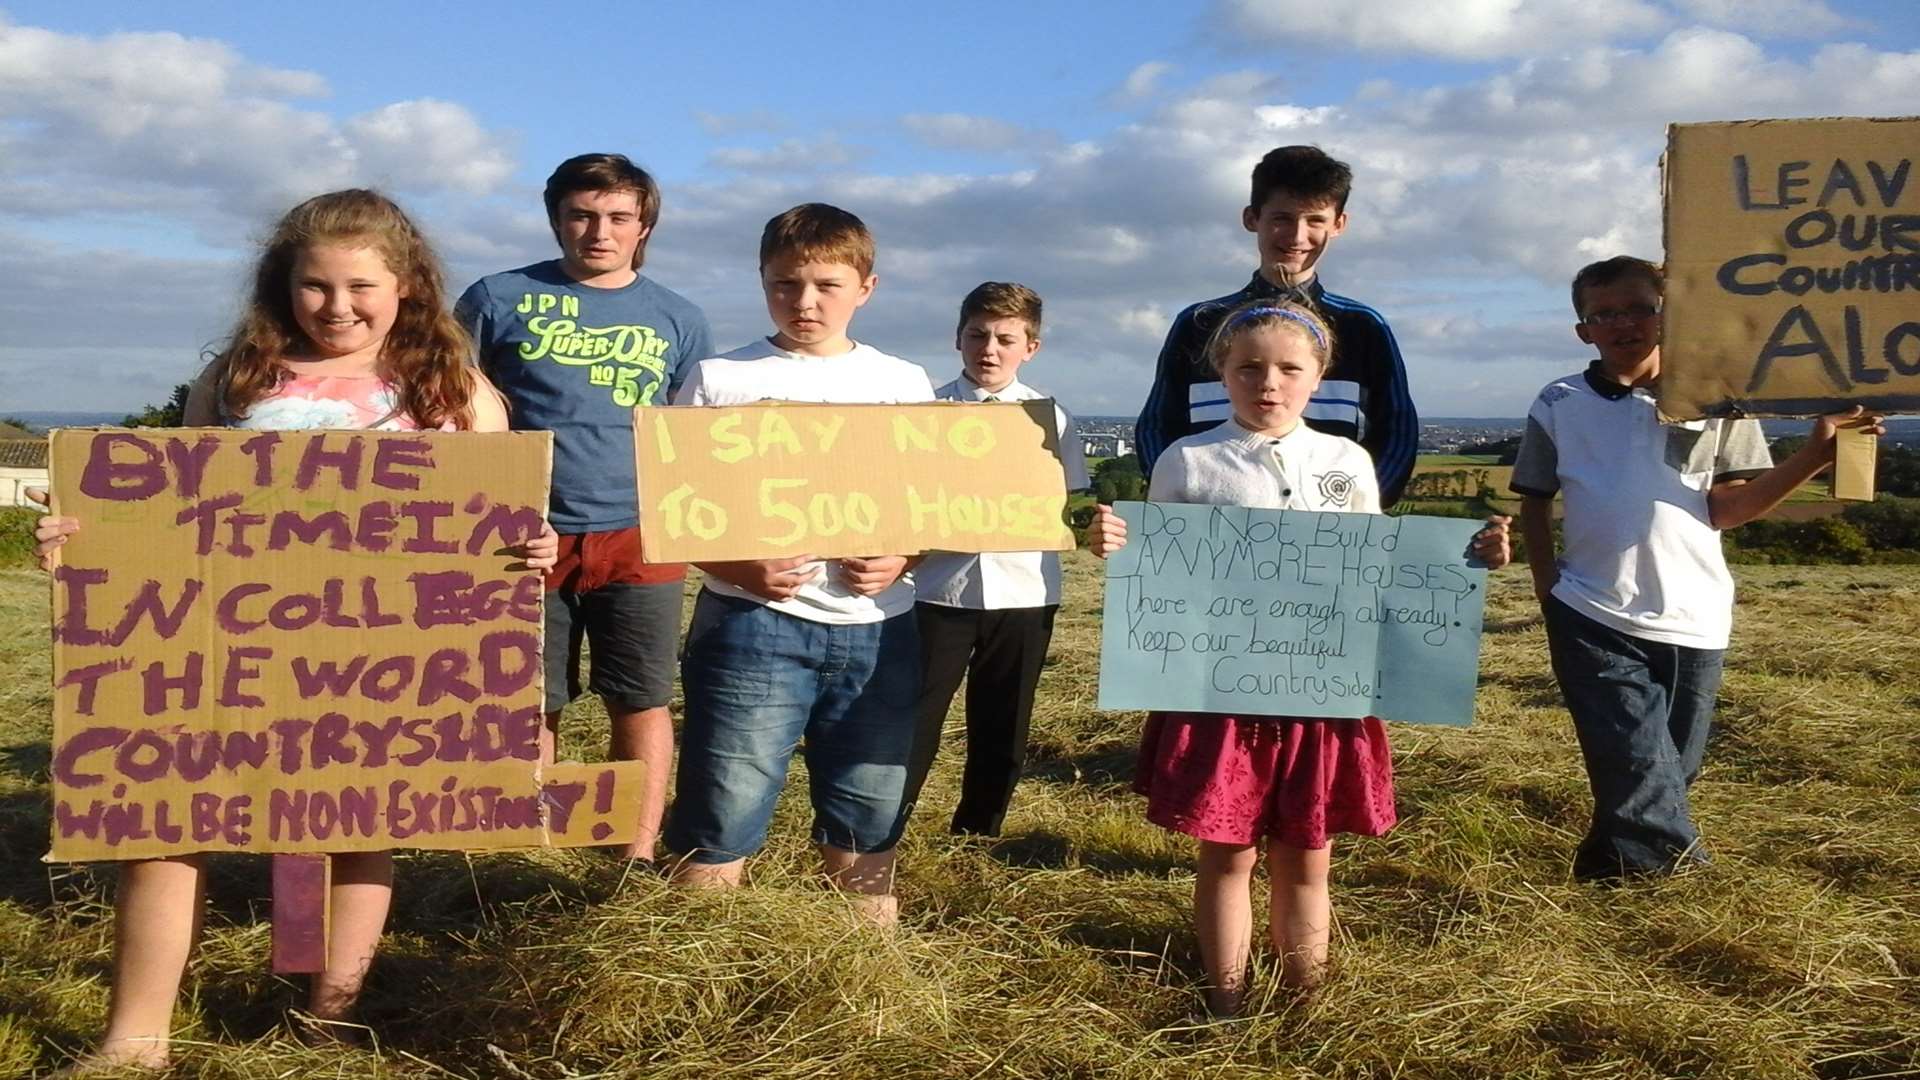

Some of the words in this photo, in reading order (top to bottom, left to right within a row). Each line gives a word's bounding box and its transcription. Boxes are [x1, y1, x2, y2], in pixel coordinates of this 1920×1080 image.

[516, 294, 579, 317] JPN
[80, 433, 218, 500] BY
[241, 431, 436, 492] THE
[655, 414, 676, 463] I
[710, 411, 845, 463] SAY
[892, 415, 996, 458] NO
[757, 478, 879, 546] 500
[53, 565, 204, 646] IN
[1205, 597, 1258, 617] are
[55, 646, 273, 716] THE
[291, 631, 537, 706] WORD
[1127, 611, 1186, 673] Keep
[1192, 632, 1240, 653] our
[53, 704, 540, 789] COUNTRYSIDE
[191, 792, 253, 846] BE
